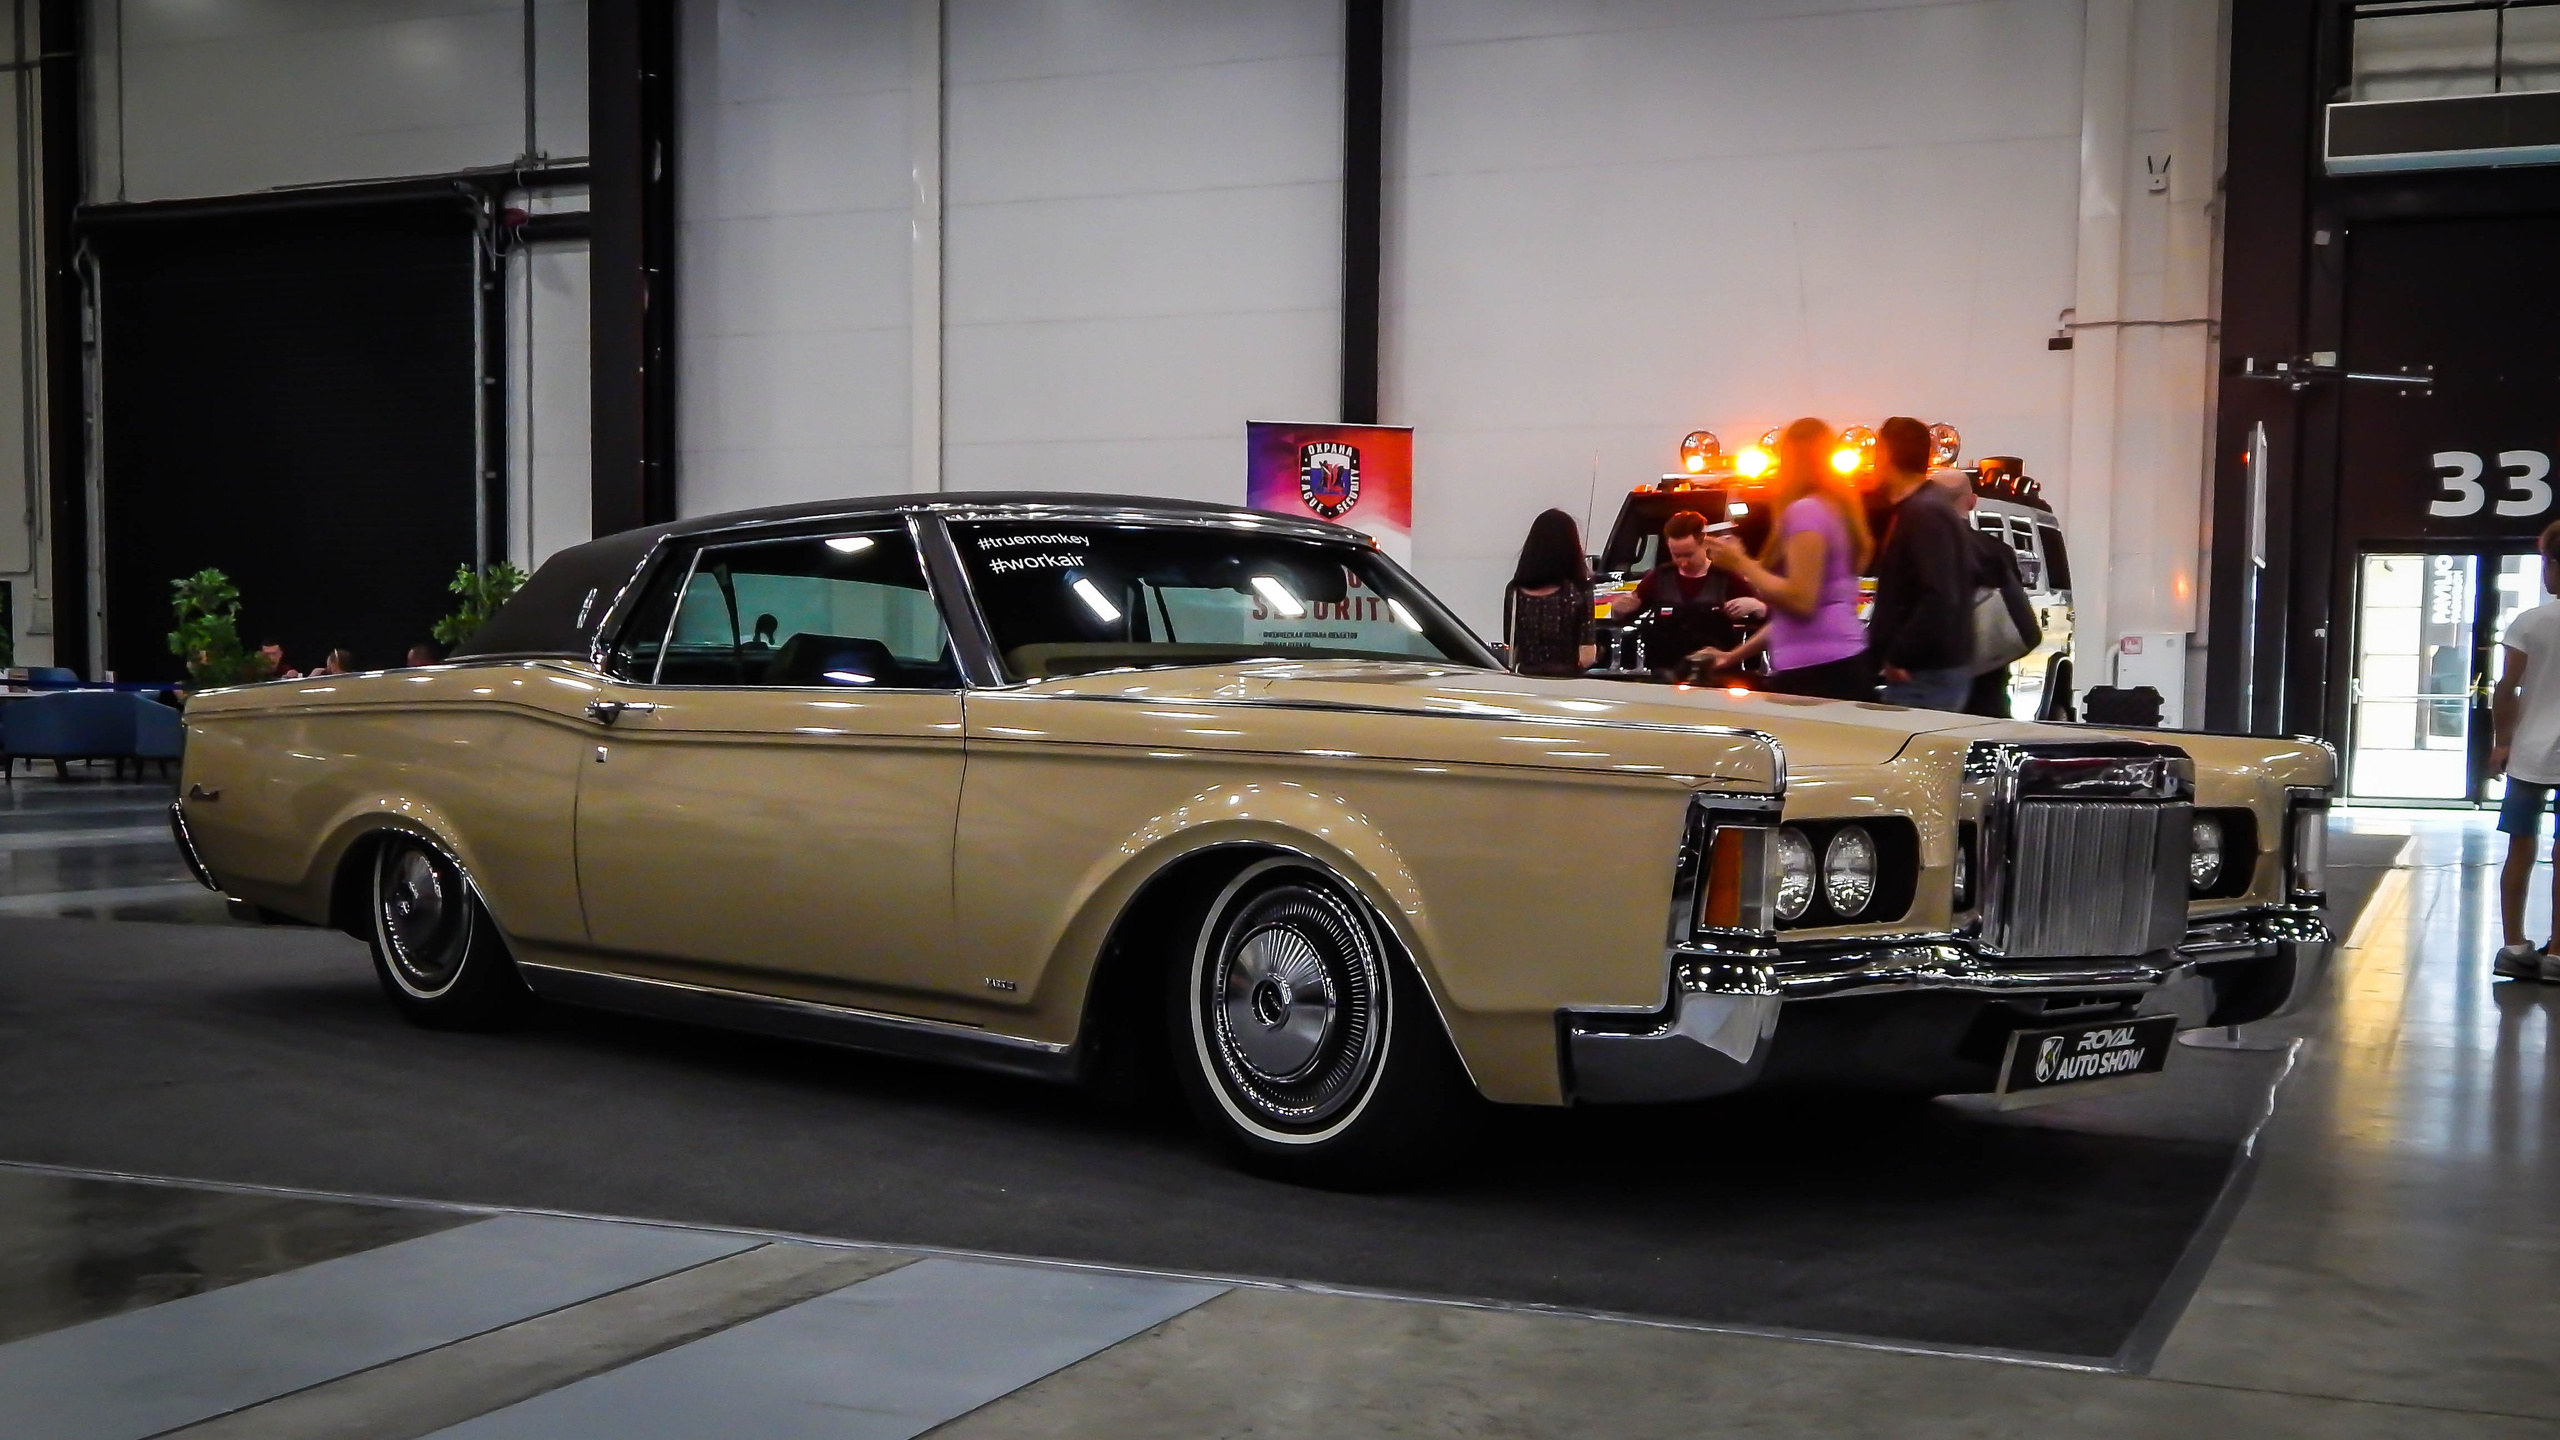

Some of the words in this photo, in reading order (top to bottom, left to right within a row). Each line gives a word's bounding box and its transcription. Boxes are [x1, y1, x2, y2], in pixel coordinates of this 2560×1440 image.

[1307, 443, 1353, 457] ОХРАНА
[1301, 467, 1324, 513] LEAGUE
[1336, 468, 1360, 513] SECURITY
[2428, 450, 2553, 517] 33
[977, 533, 1090, 551] #truemonkey
[989, 553, 1085, 574] #workair
[1252, 595, 1397, 623] SURIT
[2076, 1026, 2136, 1051] ROYAL
[2056, 1053, 2099, 1081] AUTO
[2098, 1047, 2146, 1074] SHOW
